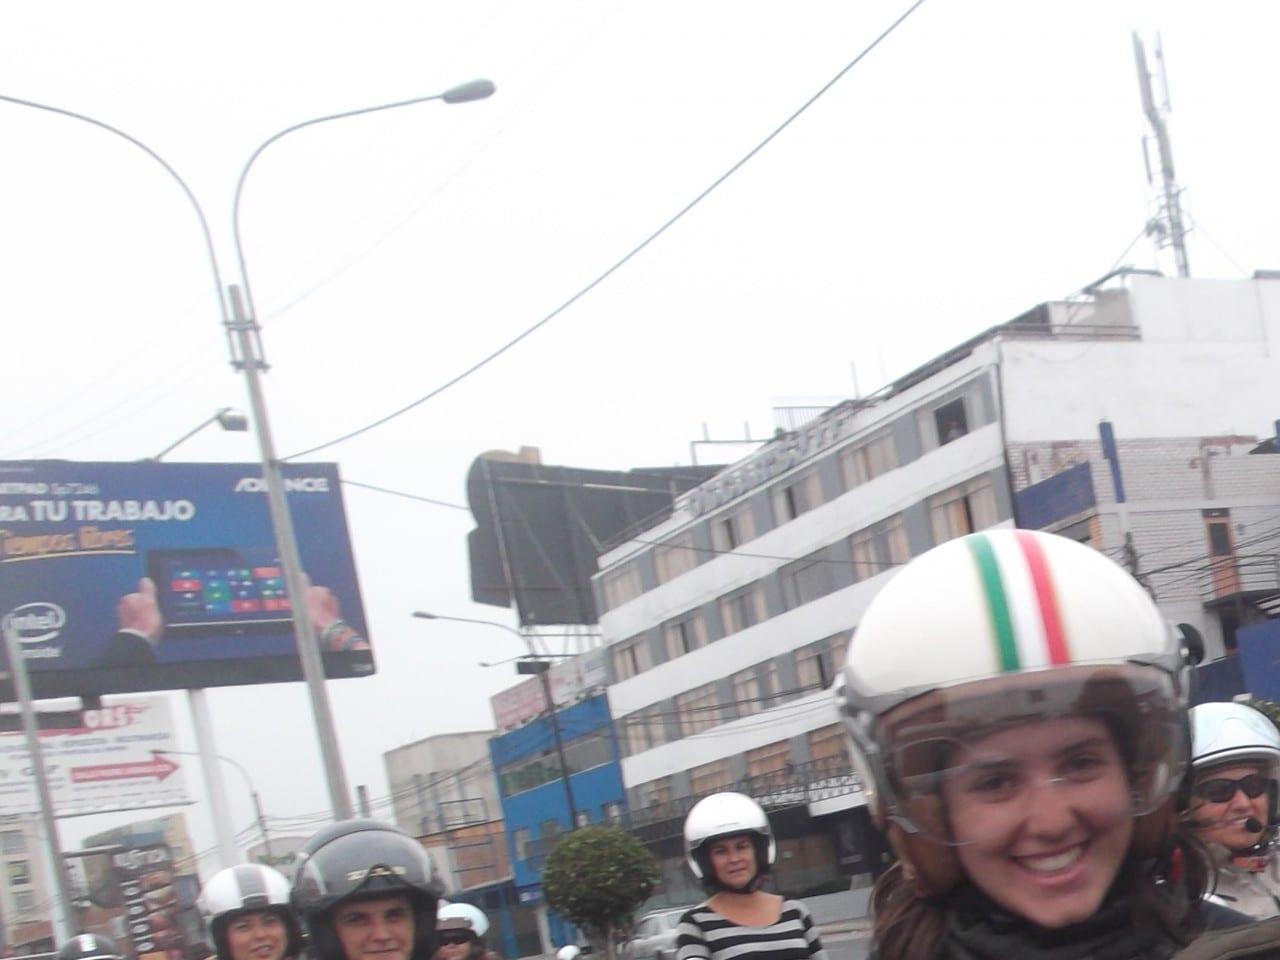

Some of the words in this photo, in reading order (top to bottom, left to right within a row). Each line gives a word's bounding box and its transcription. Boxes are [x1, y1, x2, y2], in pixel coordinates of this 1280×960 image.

[234, 477, 330, 492] ADNCE
[31, 500, 68, 521] TU
[71, 499, 196, 521] TRABAJO
